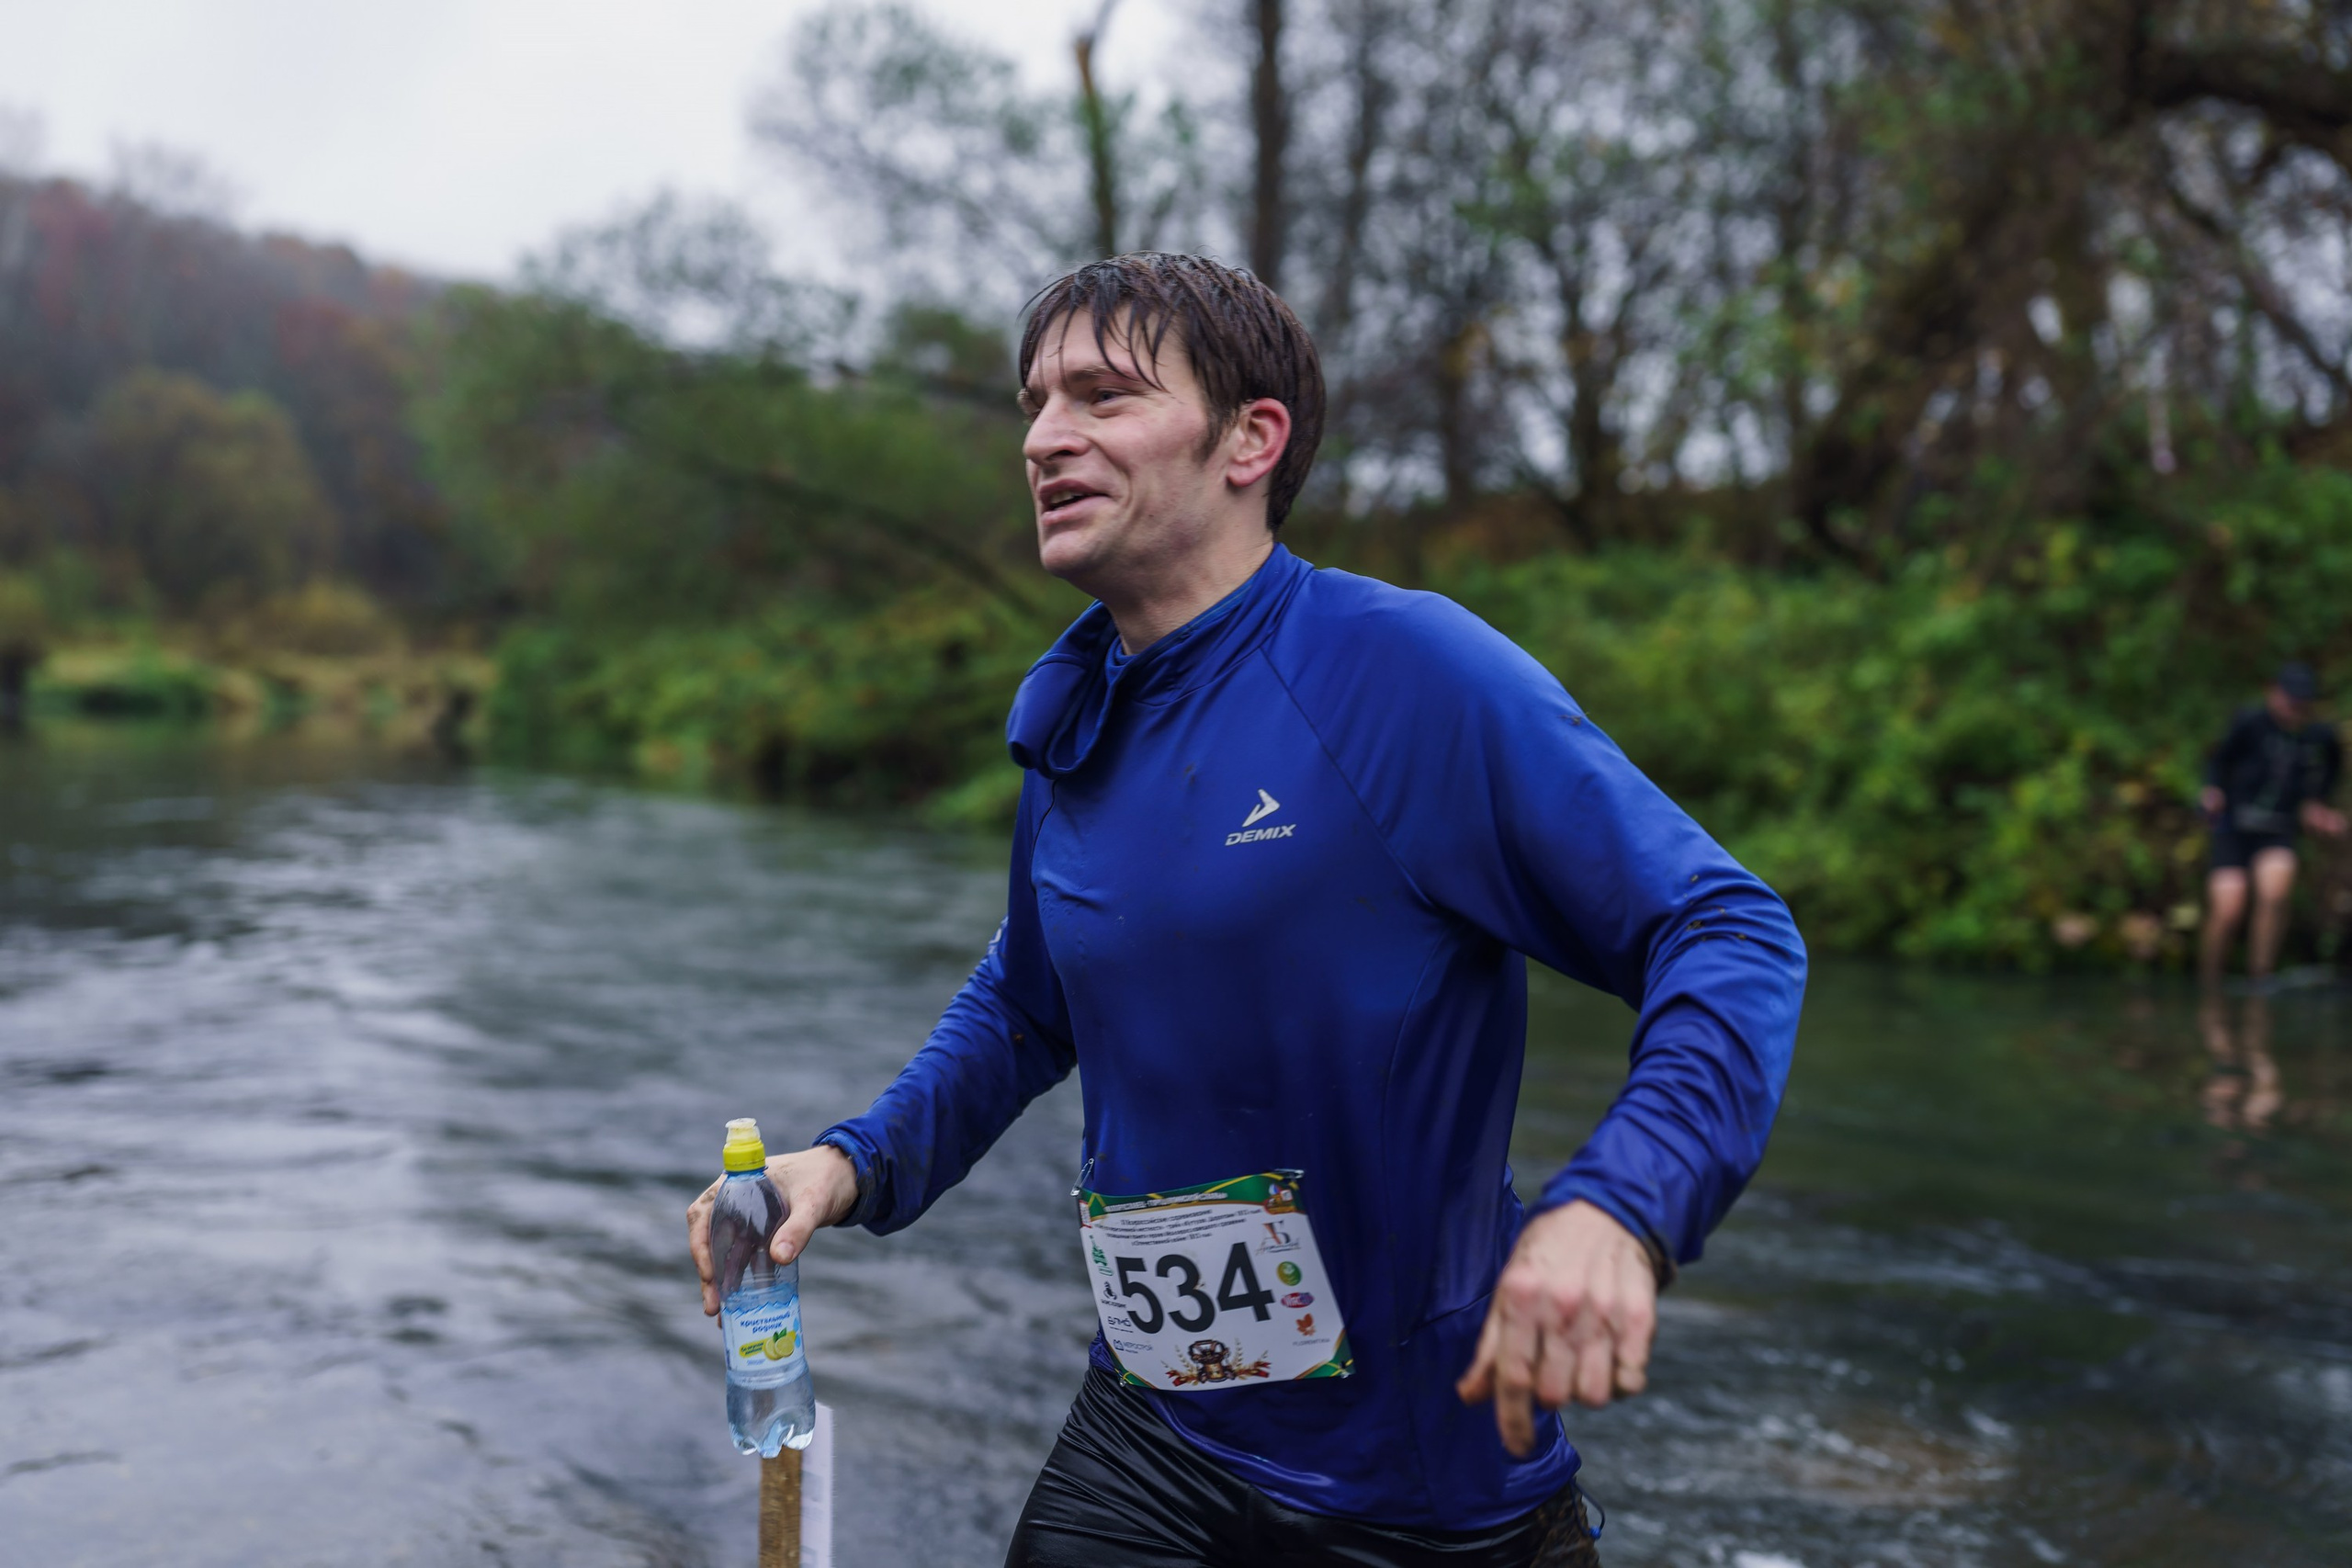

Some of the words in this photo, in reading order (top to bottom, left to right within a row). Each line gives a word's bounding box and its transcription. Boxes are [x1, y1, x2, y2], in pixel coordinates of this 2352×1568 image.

[1225, 824, 1296, 846] DEMIX
[1114, 1241, 1276, 1335] 534
[752, 1322, 783, 1334] родник
